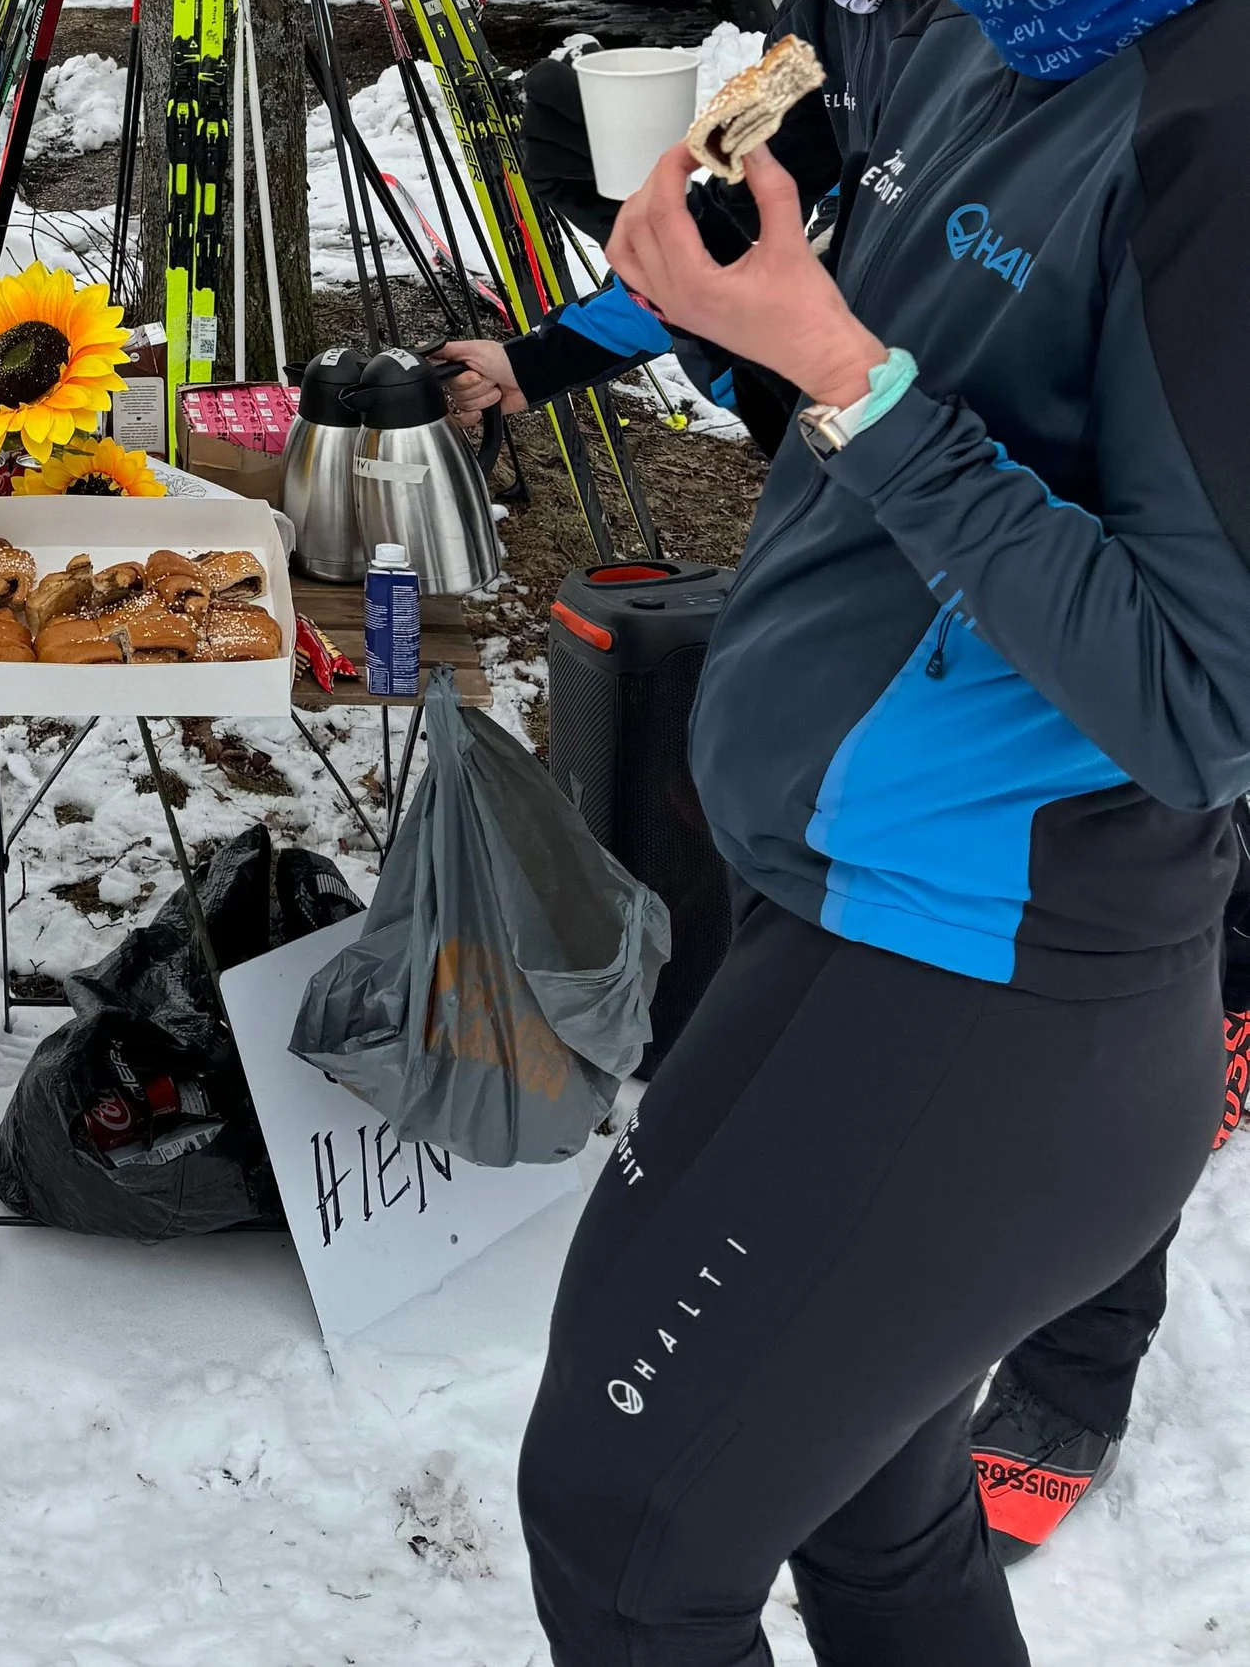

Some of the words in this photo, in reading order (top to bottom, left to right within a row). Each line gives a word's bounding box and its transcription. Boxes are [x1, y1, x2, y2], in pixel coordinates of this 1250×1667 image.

[1035, 43, 1083, 74] Levi
[434, 64, 483, 183] FISCHER
[634, 1237, 747, 1381] HALTI
